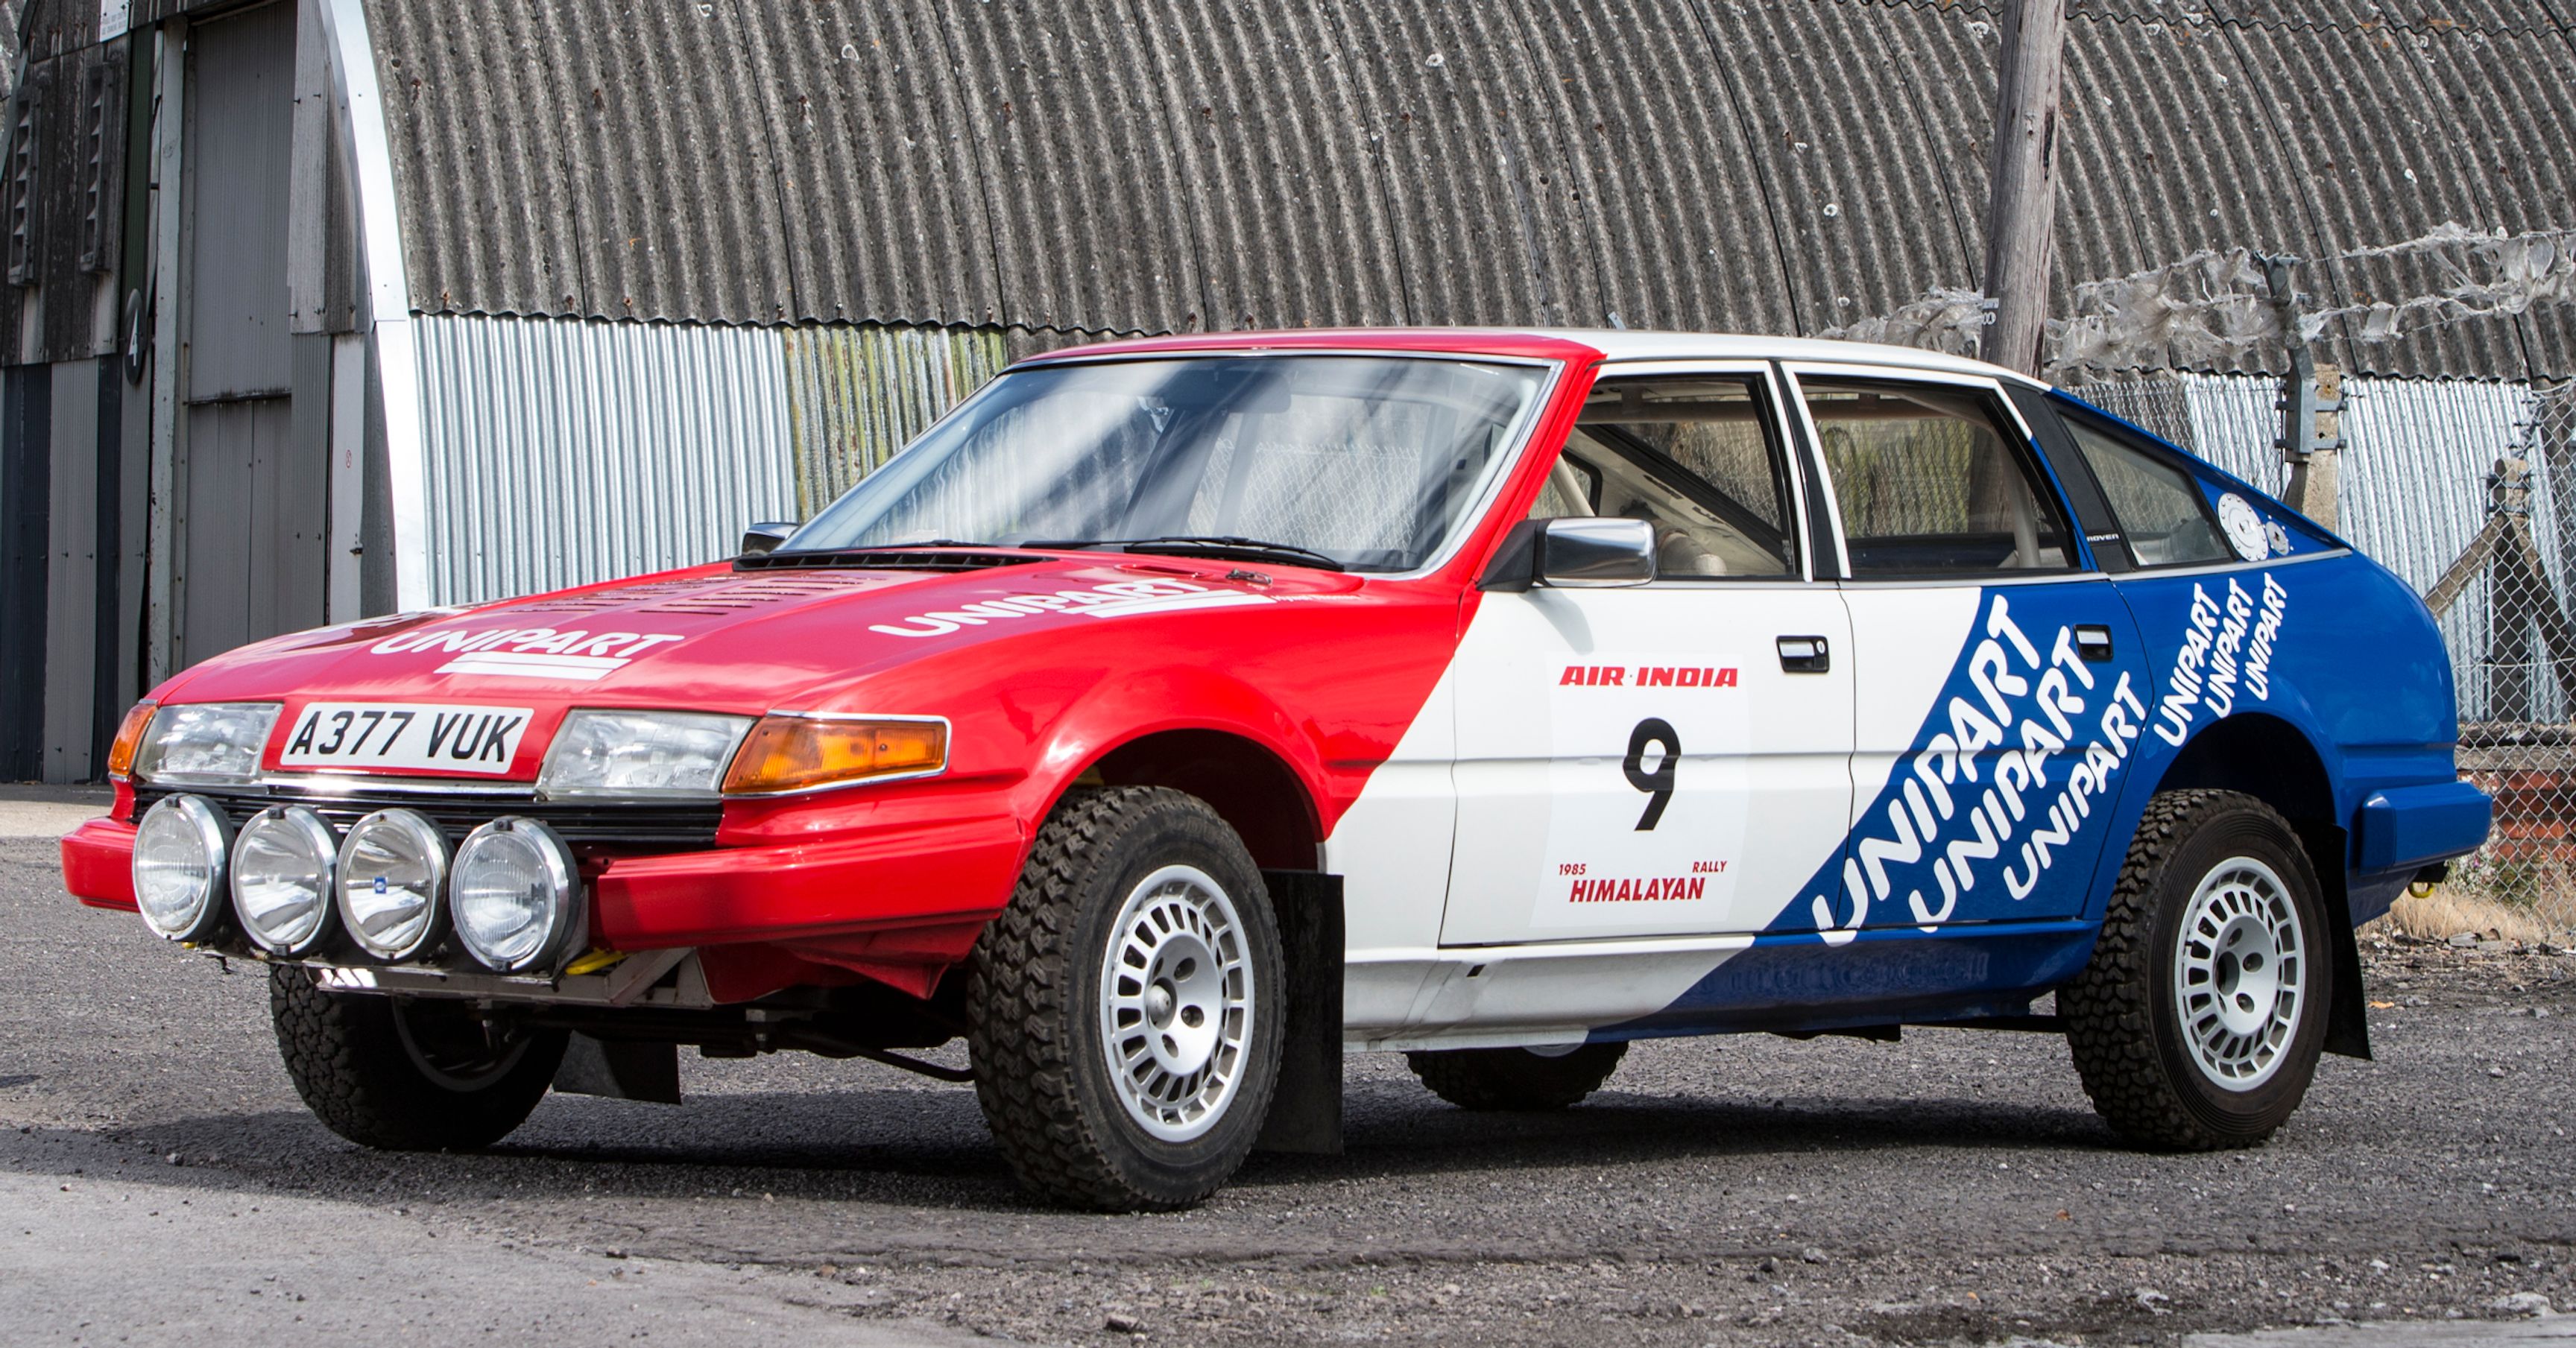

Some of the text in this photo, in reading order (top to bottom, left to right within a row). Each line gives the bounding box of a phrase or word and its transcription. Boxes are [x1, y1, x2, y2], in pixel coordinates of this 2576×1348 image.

[128, 308, 138, 367] 4
[2086, 532, 2119, 542] ROVER
[868, 578, 1208, 637] UNIPART
[2245, 572, 2288, 701] UNIPART
[370, 628, 685, 657] UNIPART
[2153, 583, 2220, 747] UNIPART
[2205, 577, 2253, 718] UNIPART
[1559, 665, 1738, 687] AIR INDIA
[288, 711, 523, 762] A377 VUK
[1623, 717, 1682, 832] 9
[1811, 594, 2041, 947] UNIPART
[1908, 625, 2094, 933] UNIPART
[2003, 671, 2146, 900] UNIPART
[1559, 861, 1728, 876] 1985 RALLY
[1569, 877, 1706, 903] HIMALAYAN
